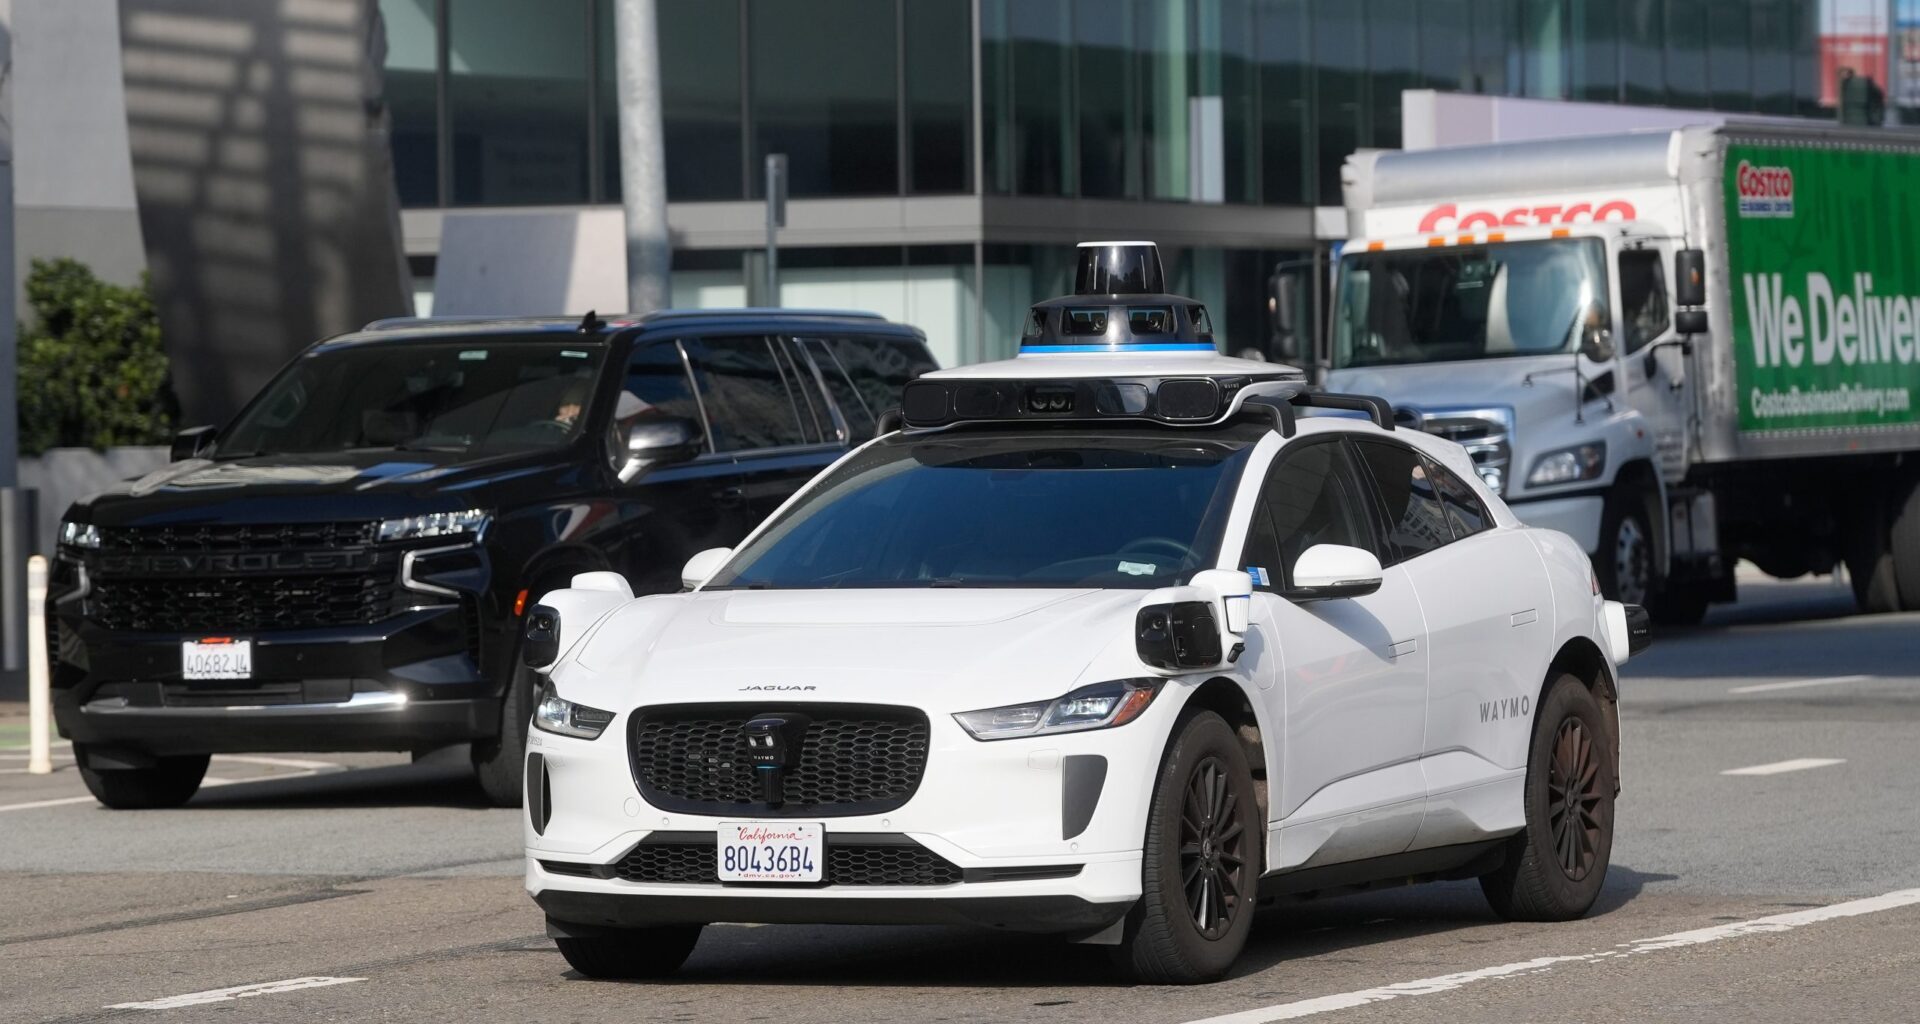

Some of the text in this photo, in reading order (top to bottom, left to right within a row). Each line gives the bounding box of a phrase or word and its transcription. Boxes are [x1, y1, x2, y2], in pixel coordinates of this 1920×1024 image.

[1738, 160, 1793, 198] COSTCO
[1743, 272, 1805, 368] We
[99, 549, 366, 573] CHEVROLET
[1479, 694, 1530, 723] WAYMO
[739, 827, 802, 844] California
[724, 845, 814, 873] 80436B4
